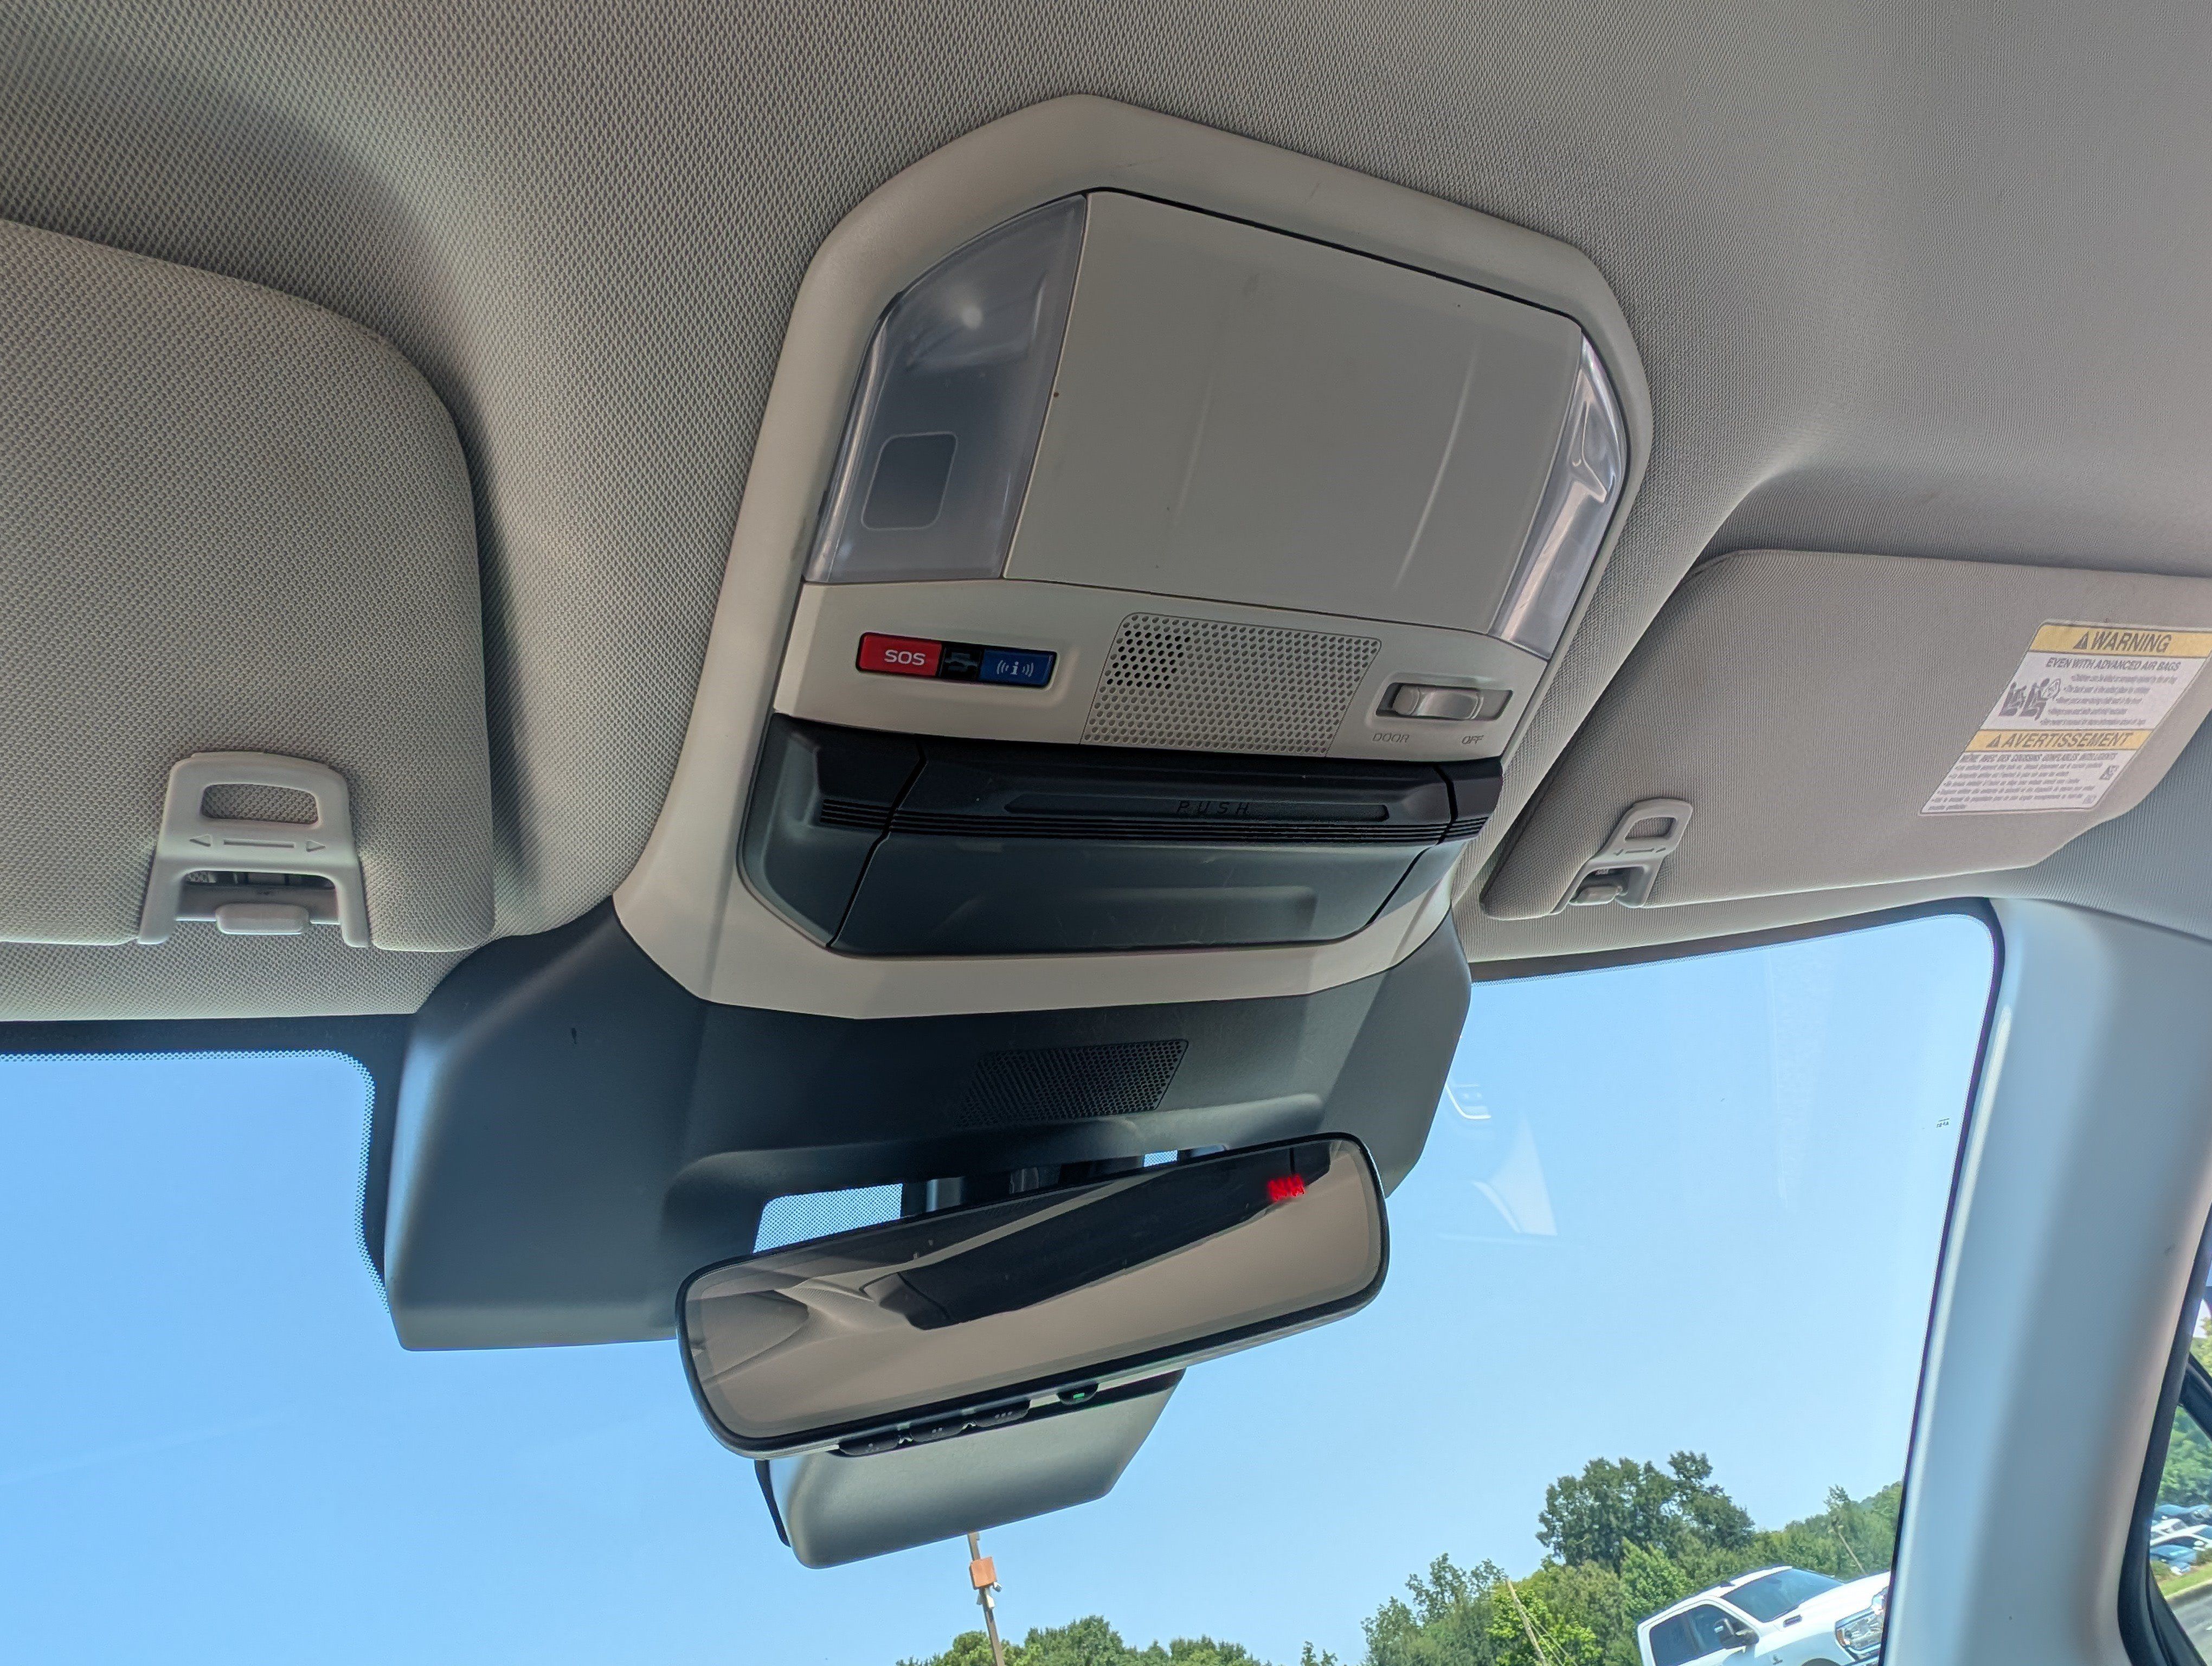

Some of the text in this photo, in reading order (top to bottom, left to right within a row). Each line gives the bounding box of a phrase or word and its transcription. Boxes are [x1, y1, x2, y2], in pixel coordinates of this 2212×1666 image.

[2091, 631, 2171, 653] WARNING
[884, 649, 926, 667] SOS
[2046, 657, 2072, 668] EVEN
[2071, 658, 2095, 669] WITH
[2093, 659, 2142, 670] ADVANCED
[2156, 661, 2181, 672] BAGS
[1372, 733, 1410, 743] DOOR
[1461, 735, 1484, 745] OFF
[2001, 732, 2133, 748] AVERTISSEMENT
[1176, 799, 1250, 815] PUSH
